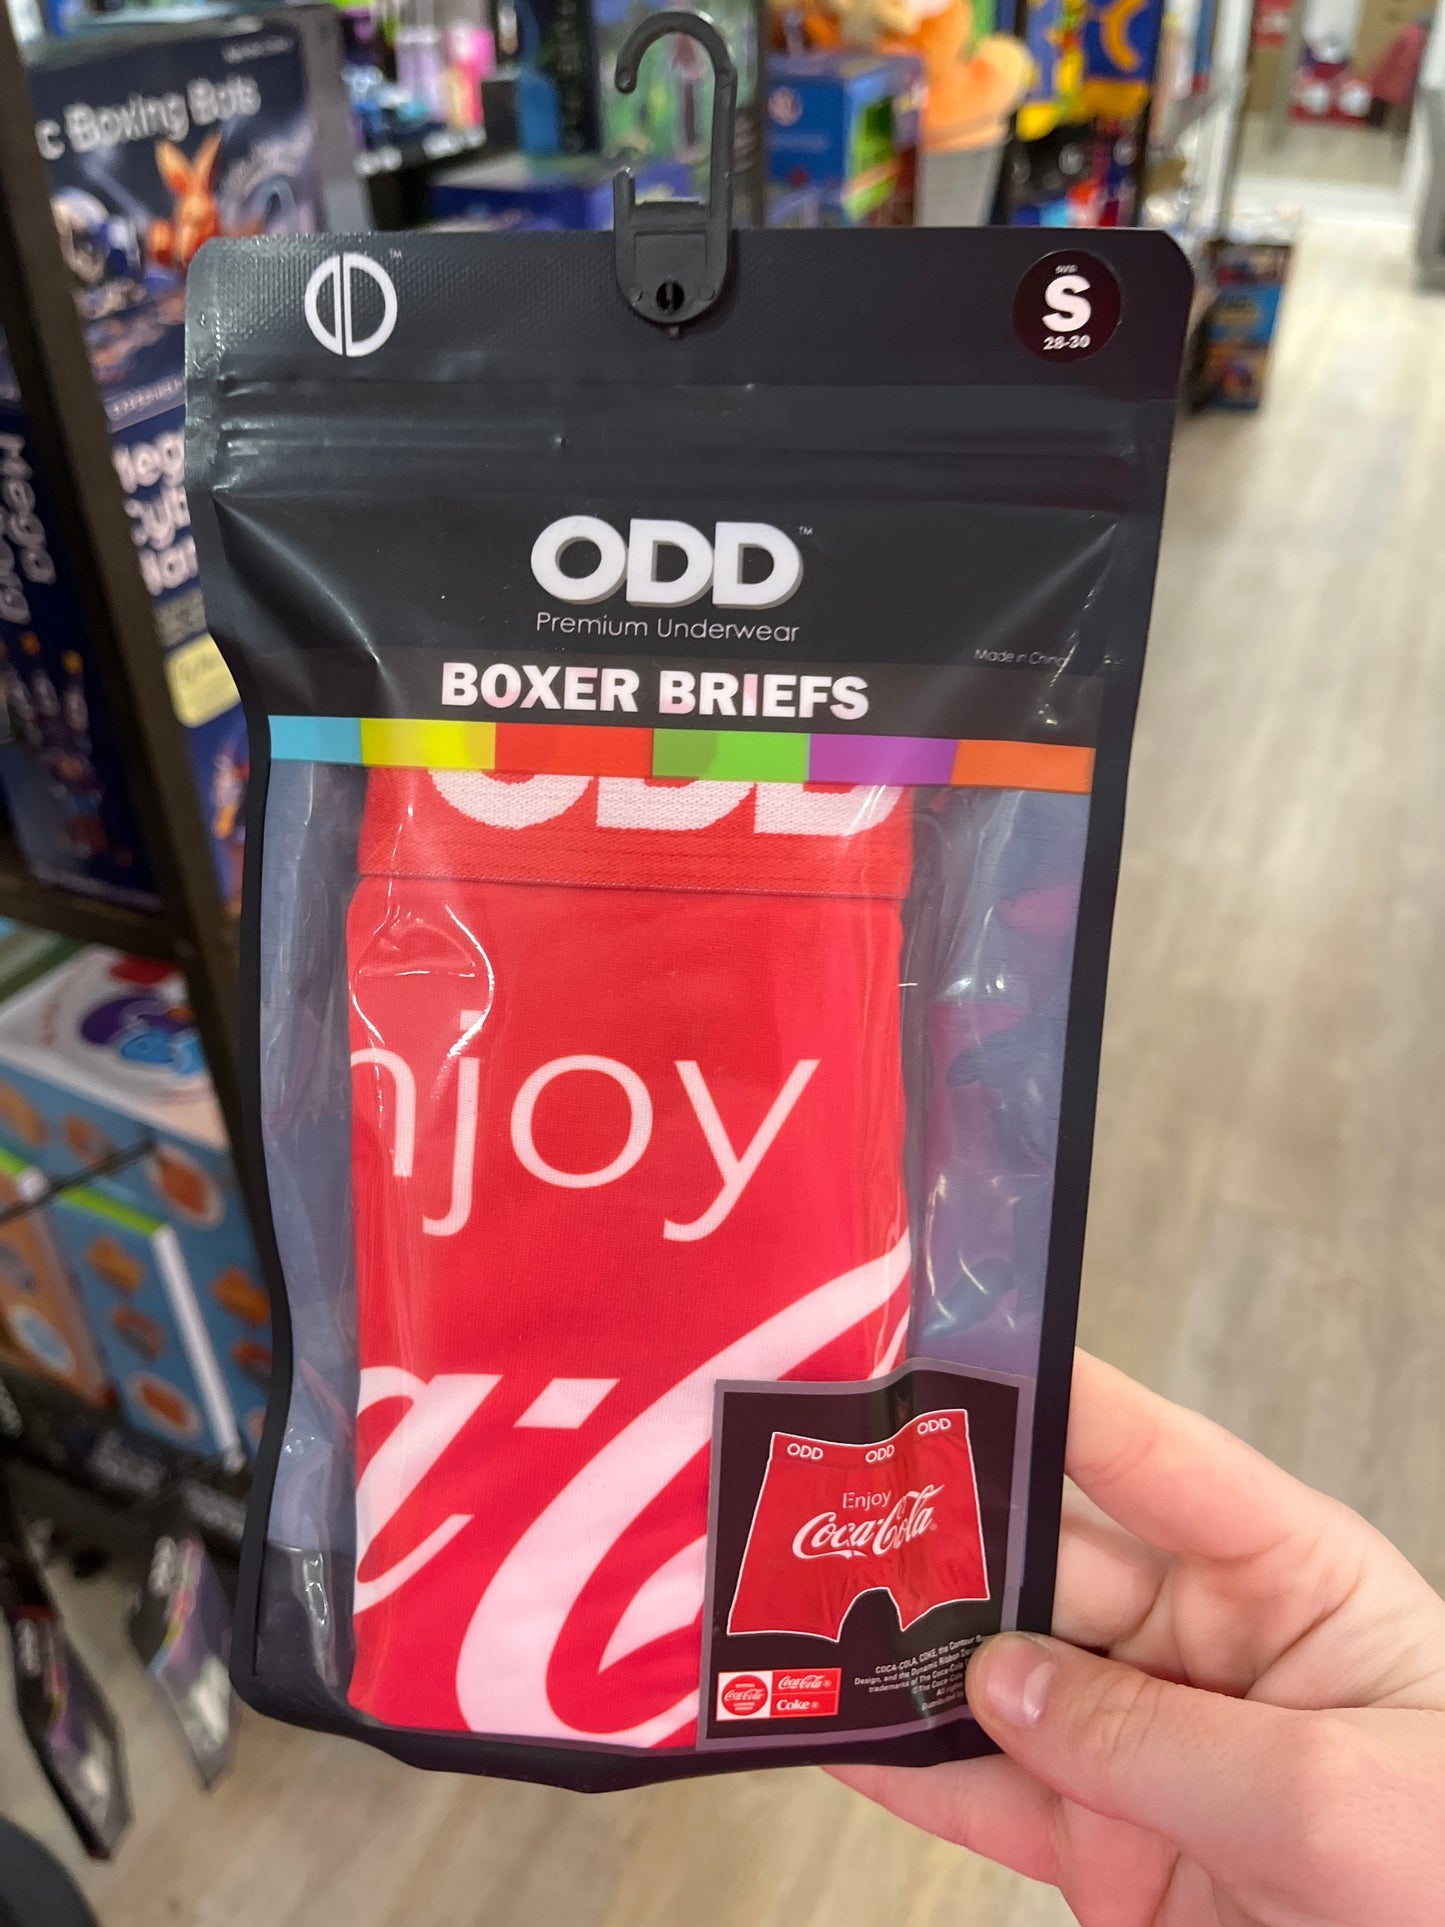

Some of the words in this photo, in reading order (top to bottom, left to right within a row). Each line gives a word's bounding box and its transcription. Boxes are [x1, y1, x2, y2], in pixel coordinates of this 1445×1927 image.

[65, 93, 190, 153] Boxing
[187, 75, 262, 126] Bots
[1042, 275, 1091, 332] S
[1043, 334, 1091, 350] 28-30
[530, 515, 804, 610] ODD
[536, 612, 648, 637] Premium
[657, 619, 800, 642] Underwear
[975, 649, 1014, 663] Made
[1016, 653, 1026, 663] in
[441, 662, 640, 713] BOXER
[659, 670, 869, 720] BRIEFS
[916, 1417, 951, 1435] ODD
[786, 1443, 824, 1460] ODD
[865, 1444, 895, 1463] ODD
[842, 1490, 892, 1511] Enjoy
[792, 1484, 945, 1560] Coca-Cola
[911, 1661, 938, 1677] Dynamic
[776, 1699, 811, 1711] Coke
